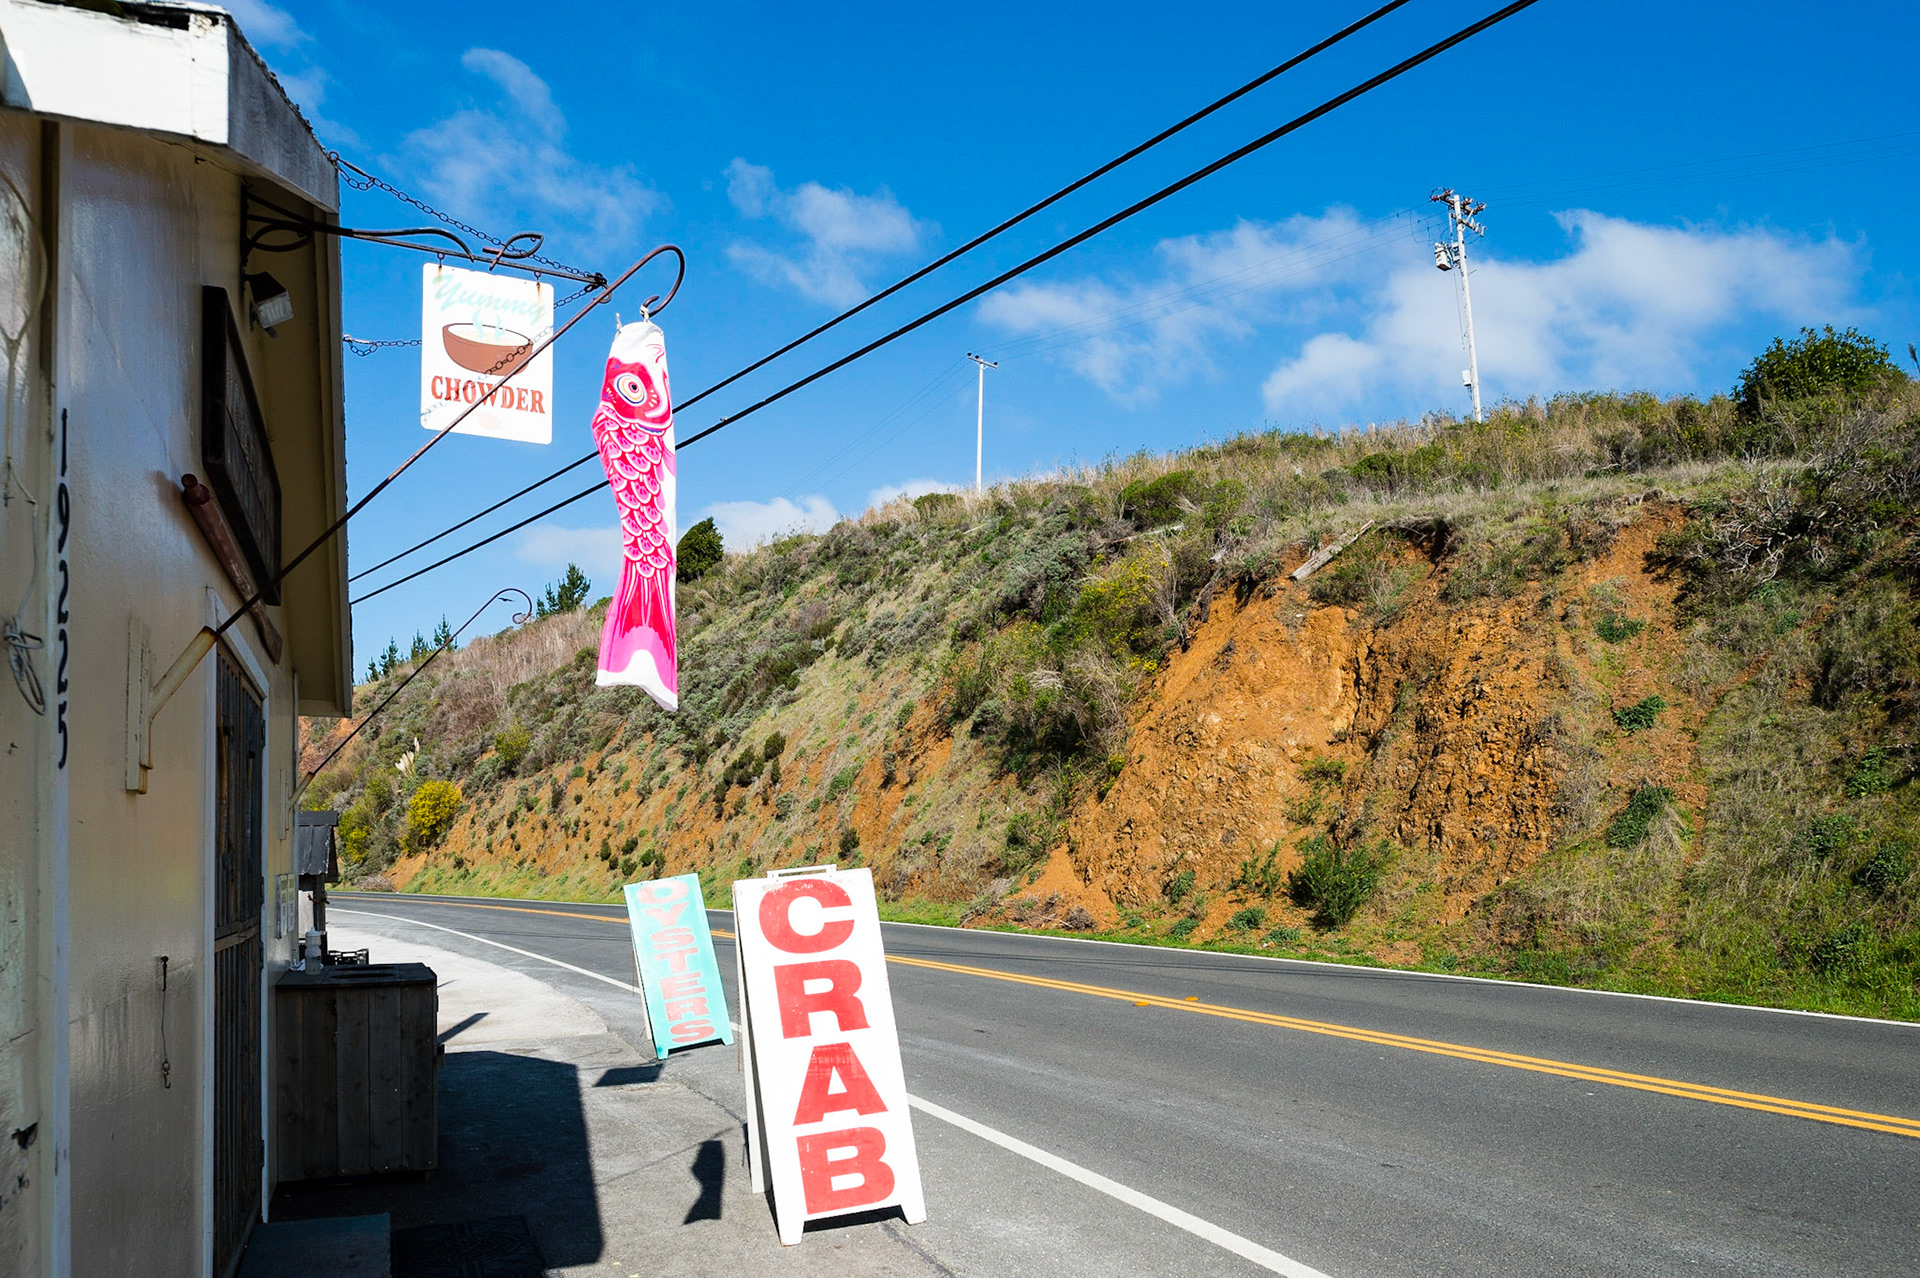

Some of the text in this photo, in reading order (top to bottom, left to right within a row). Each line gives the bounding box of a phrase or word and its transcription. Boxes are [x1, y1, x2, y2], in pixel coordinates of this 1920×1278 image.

[432, 273, 547, 327] Yummy
[431, 375, 545, 414] CHOWDER
[57, 407, 70, 770] 19225
[636, 879, 716, 1043] OYSTERS
[758, 878, 896, 1216] CRAB
